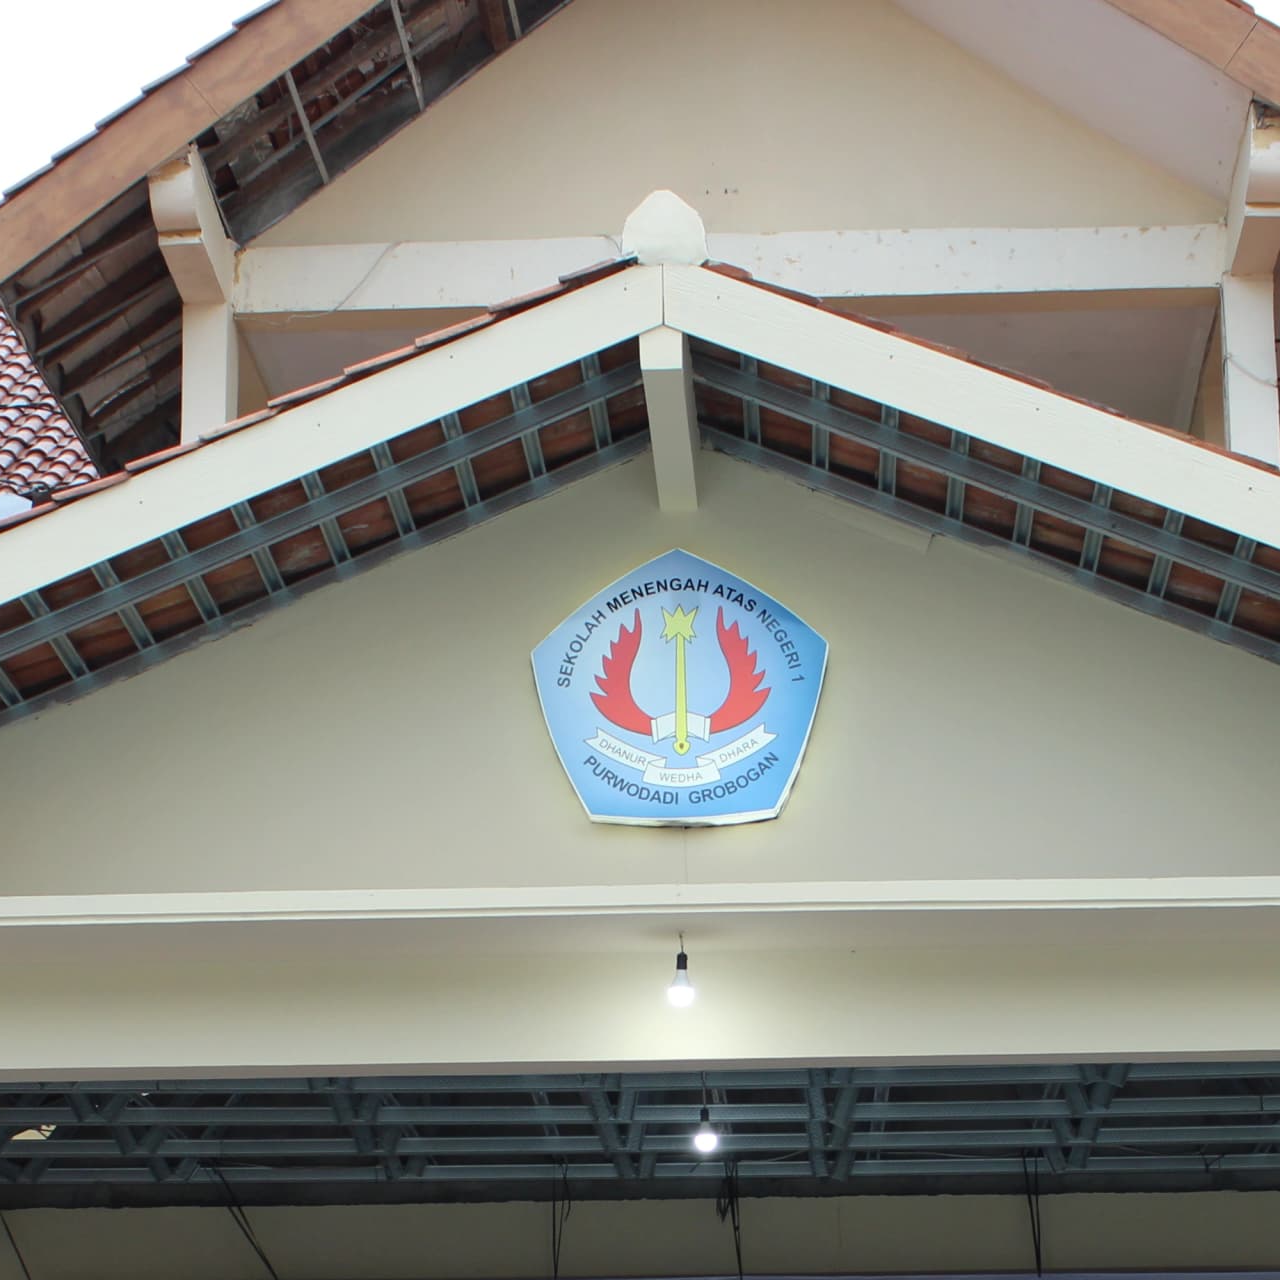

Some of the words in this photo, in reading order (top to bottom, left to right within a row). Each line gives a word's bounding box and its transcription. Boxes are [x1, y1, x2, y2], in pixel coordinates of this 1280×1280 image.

[557, 609, 607, 688] SEKOLAH
[606, 578, 709, 614] MENENGAH
[712, 584, 757, 613] ATAS
[756, 609, 801, 671] NEGERI
[791, 675, 805, 684] 1
[599, 737, 647, 766] DHANUR
[719, 737, 758, 764] DHARA
[583, 755, 679, 805] PURWODADI
[688, 752, 779, 805] GROBOGAN
[659, 771, 703, 783] WEDHA
